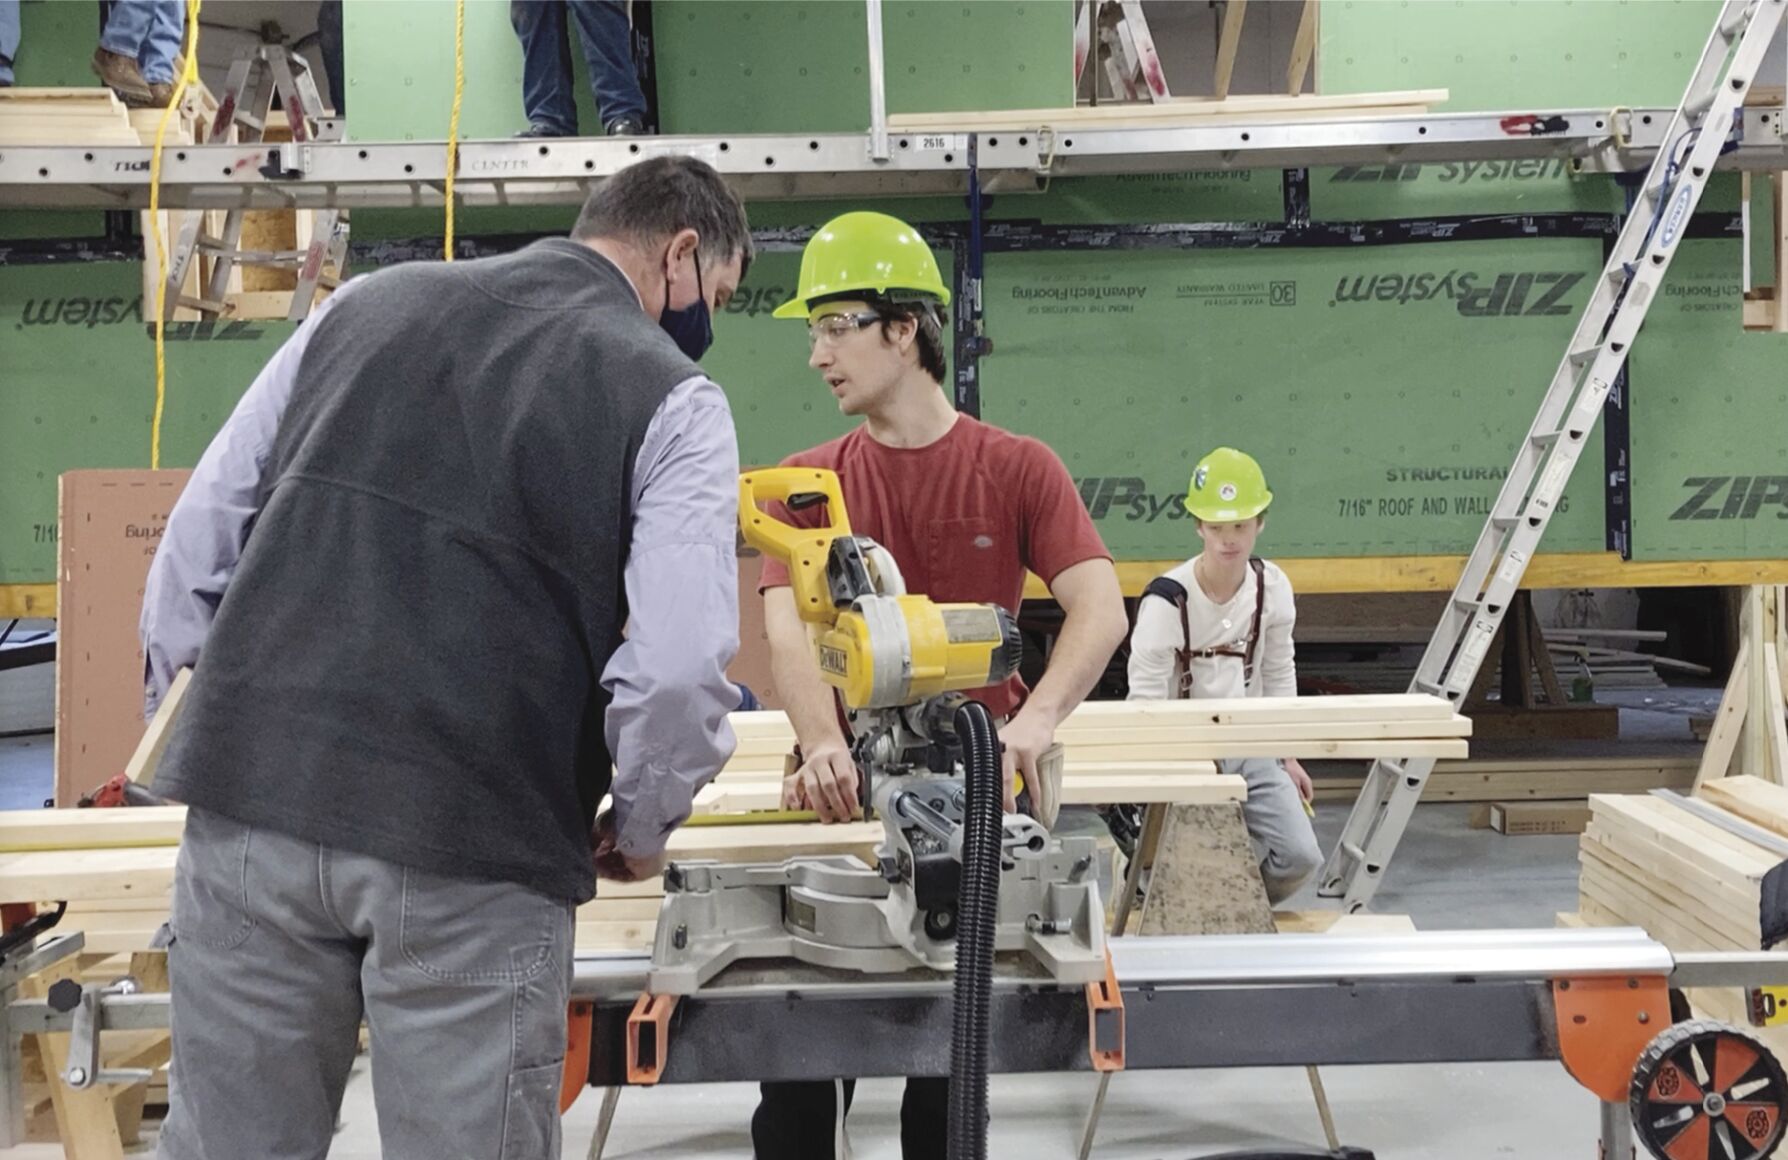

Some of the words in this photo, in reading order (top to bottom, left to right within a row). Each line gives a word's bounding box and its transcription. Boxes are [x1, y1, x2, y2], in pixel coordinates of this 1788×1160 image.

[923, 137, 945, 149] 2616
[1271, 284, 1295, 304] 30
[1378, 497, 1415, 517] ROOF
[1421, 497, 1448, 516] AND
[1455, 495, 1491, 516] WALL
